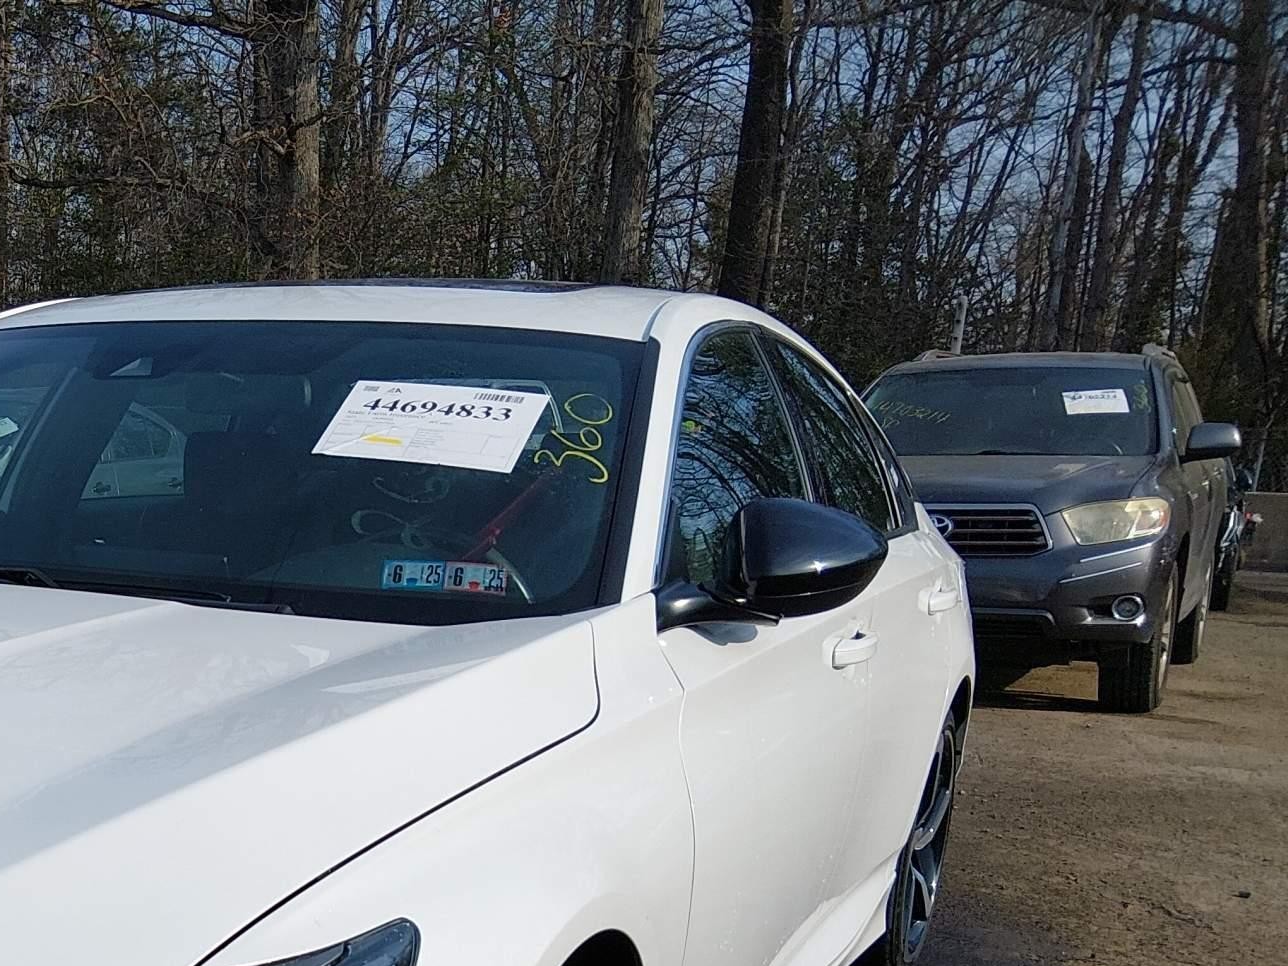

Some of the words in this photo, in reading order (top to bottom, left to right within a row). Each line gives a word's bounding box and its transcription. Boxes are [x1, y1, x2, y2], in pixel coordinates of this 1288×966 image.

[362, 398, 513, 422] 44694833
[533, 393, 613, 484] 360
[392, 564, 404, 584] 6
[425, 564, 442, 584] 25
[452, 567, 464, 587] 6
